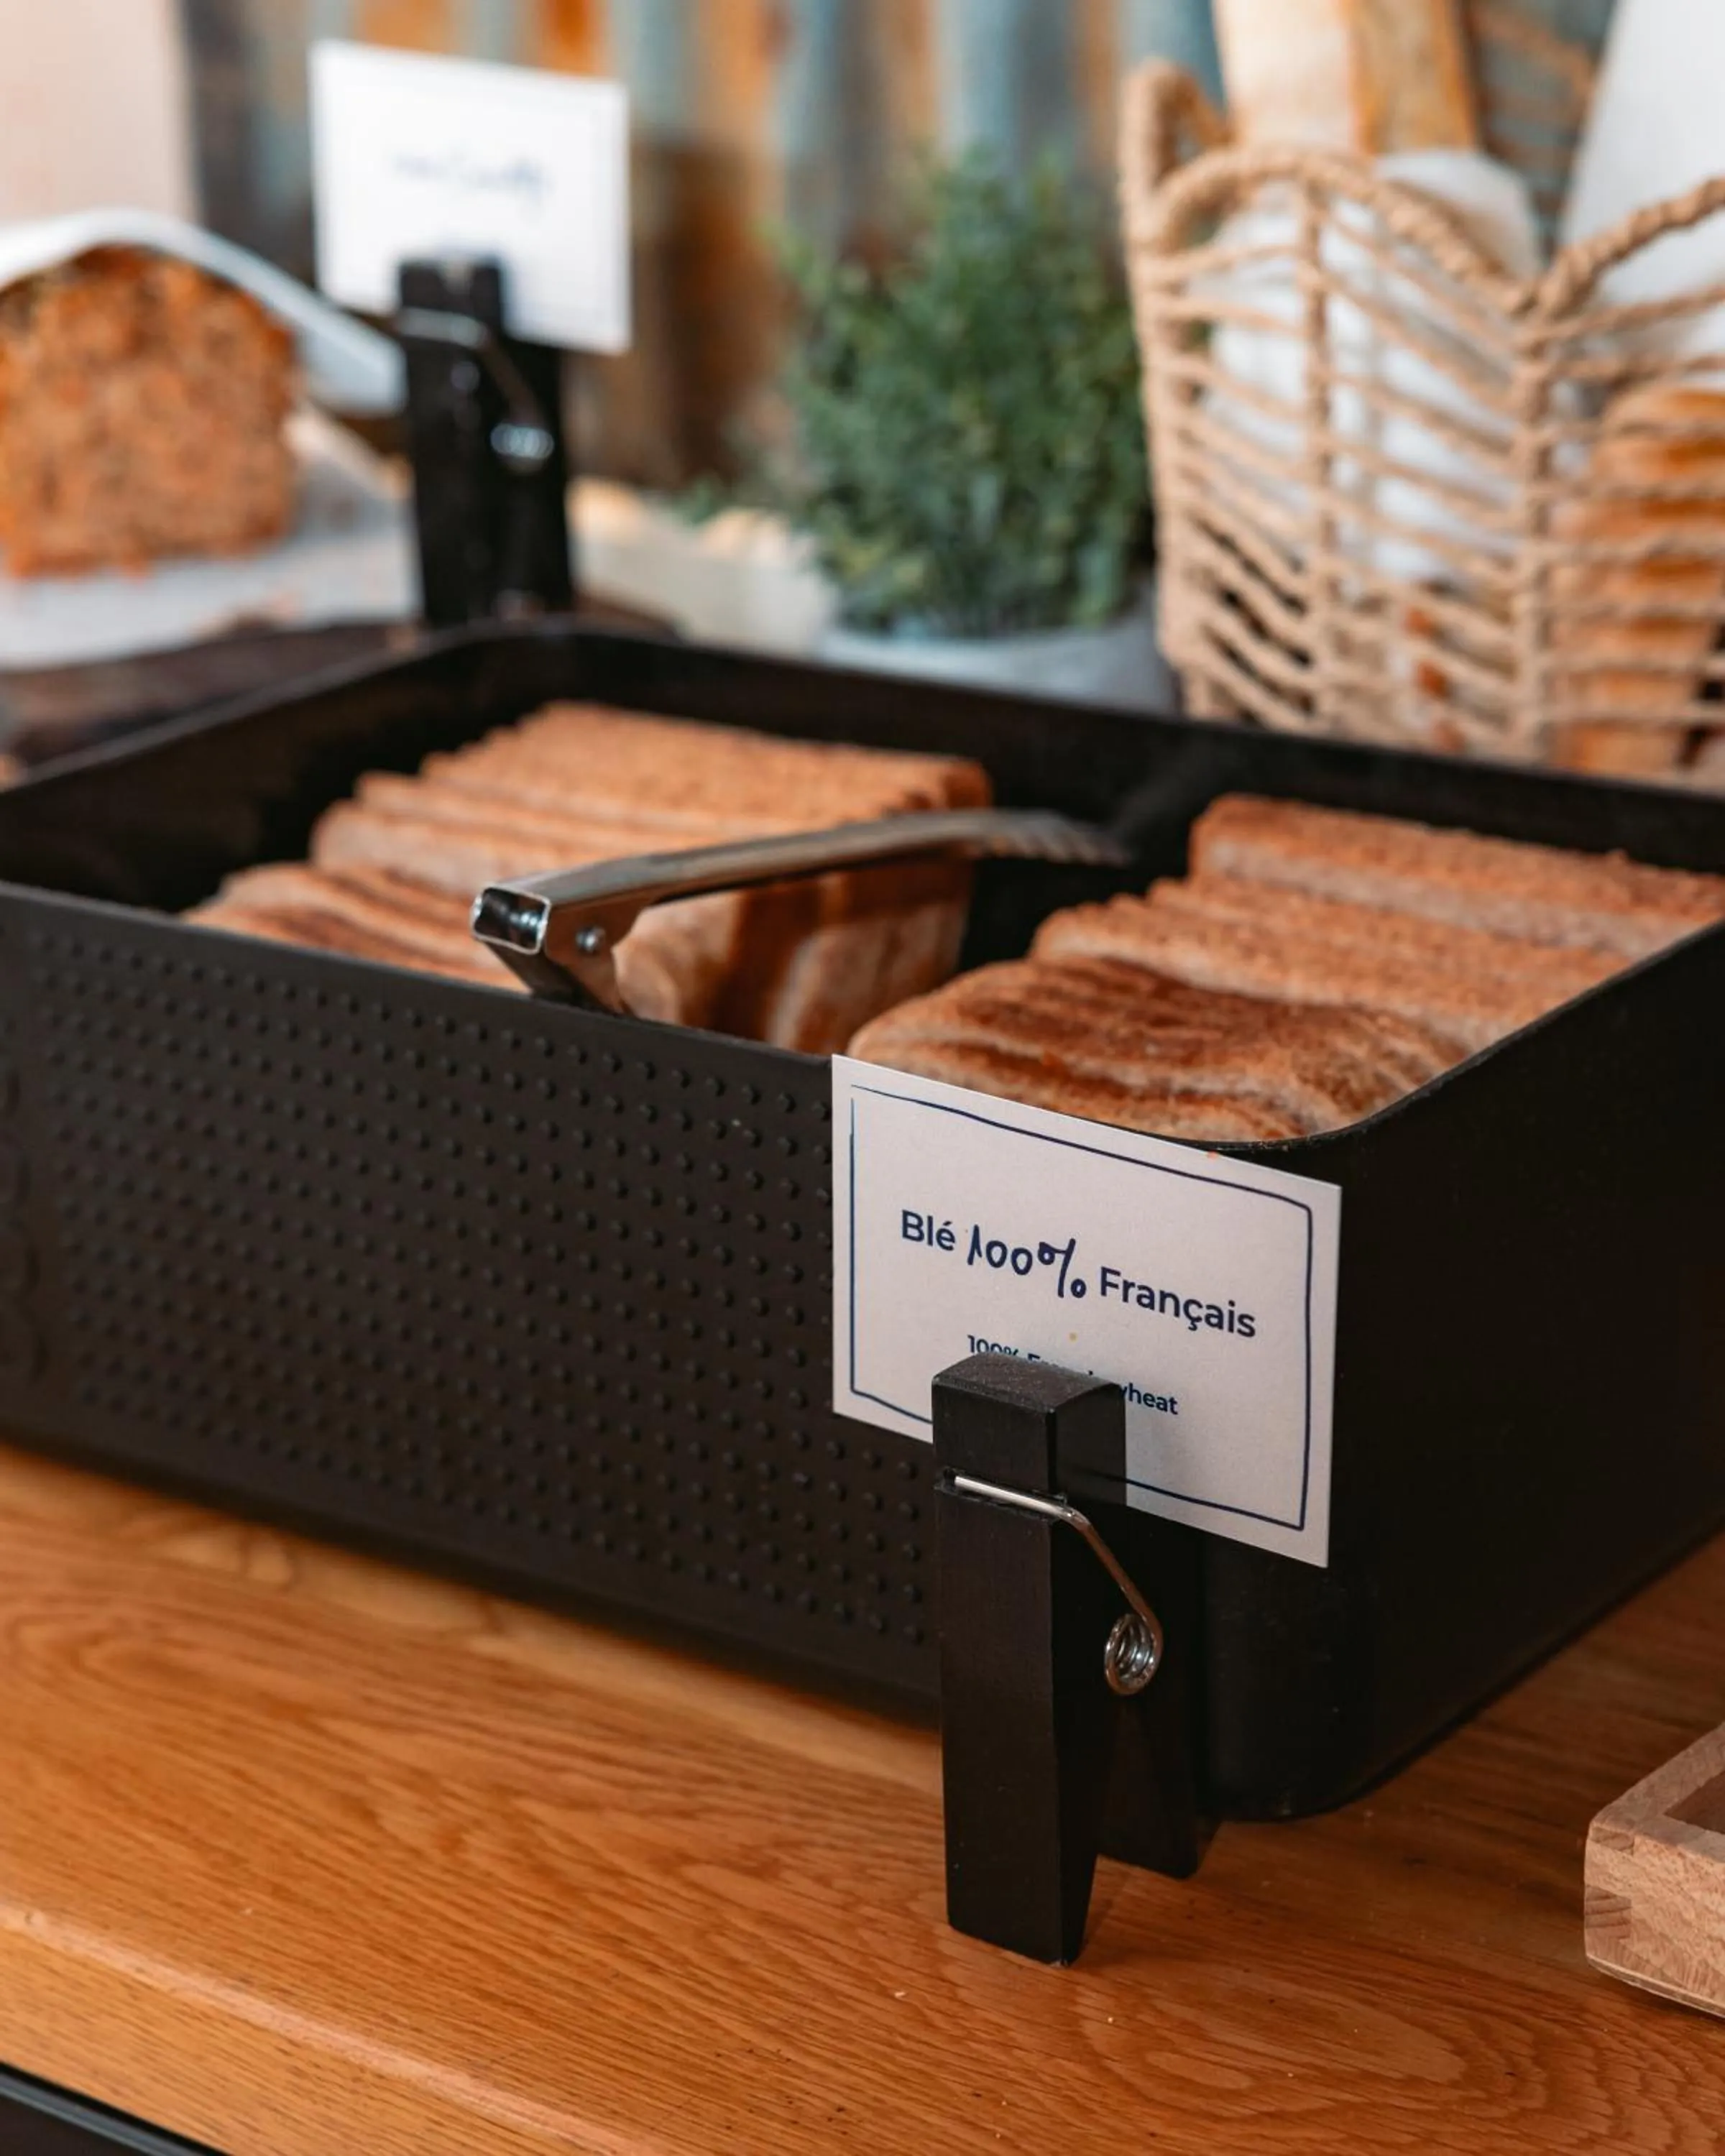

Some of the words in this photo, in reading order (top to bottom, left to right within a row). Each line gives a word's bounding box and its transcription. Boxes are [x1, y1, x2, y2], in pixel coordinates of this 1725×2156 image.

[901, 1209, 957, 1252] Blé
[966, 1223, 1088, 1299] 100%
[1100, 1266, 1257, 1339] Français
